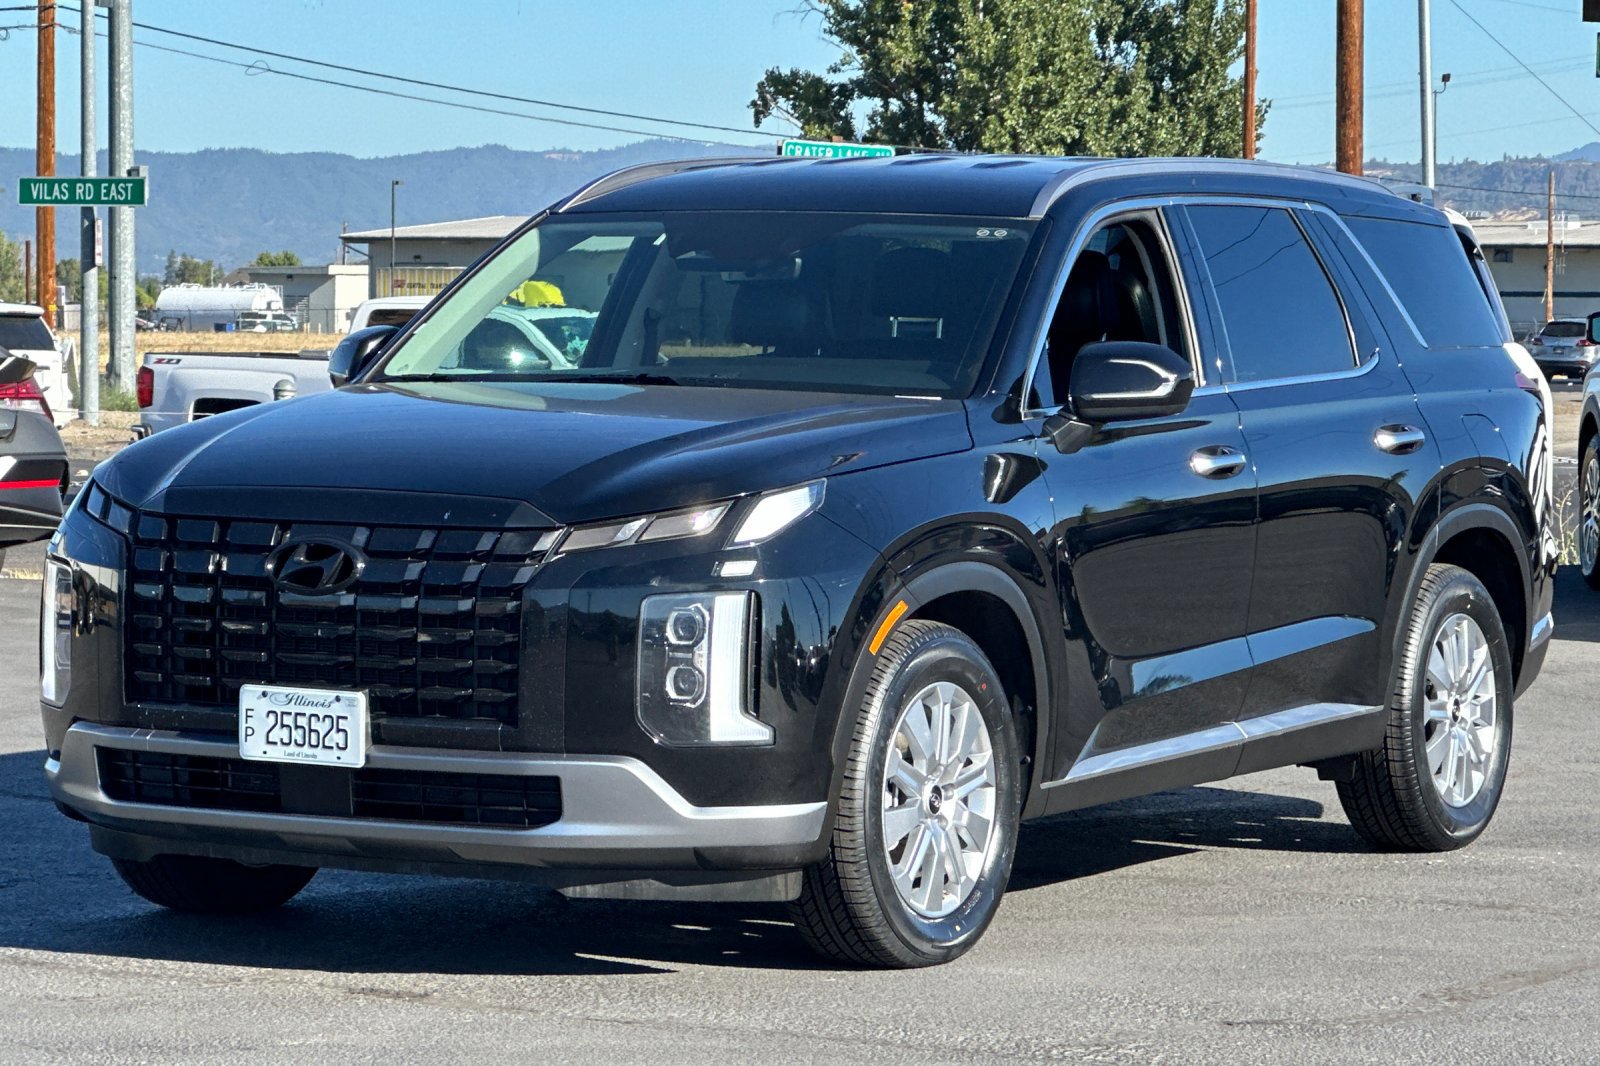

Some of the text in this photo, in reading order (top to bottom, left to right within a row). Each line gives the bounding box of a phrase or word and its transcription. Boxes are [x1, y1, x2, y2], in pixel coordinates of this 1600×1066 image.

[787, 144, 834, 157] CRATER
[31, 183, 133, 201] VILAS RD EAST
[284, 692, 332, 708] Illinois
[266, 710, 348, 751] 255625
